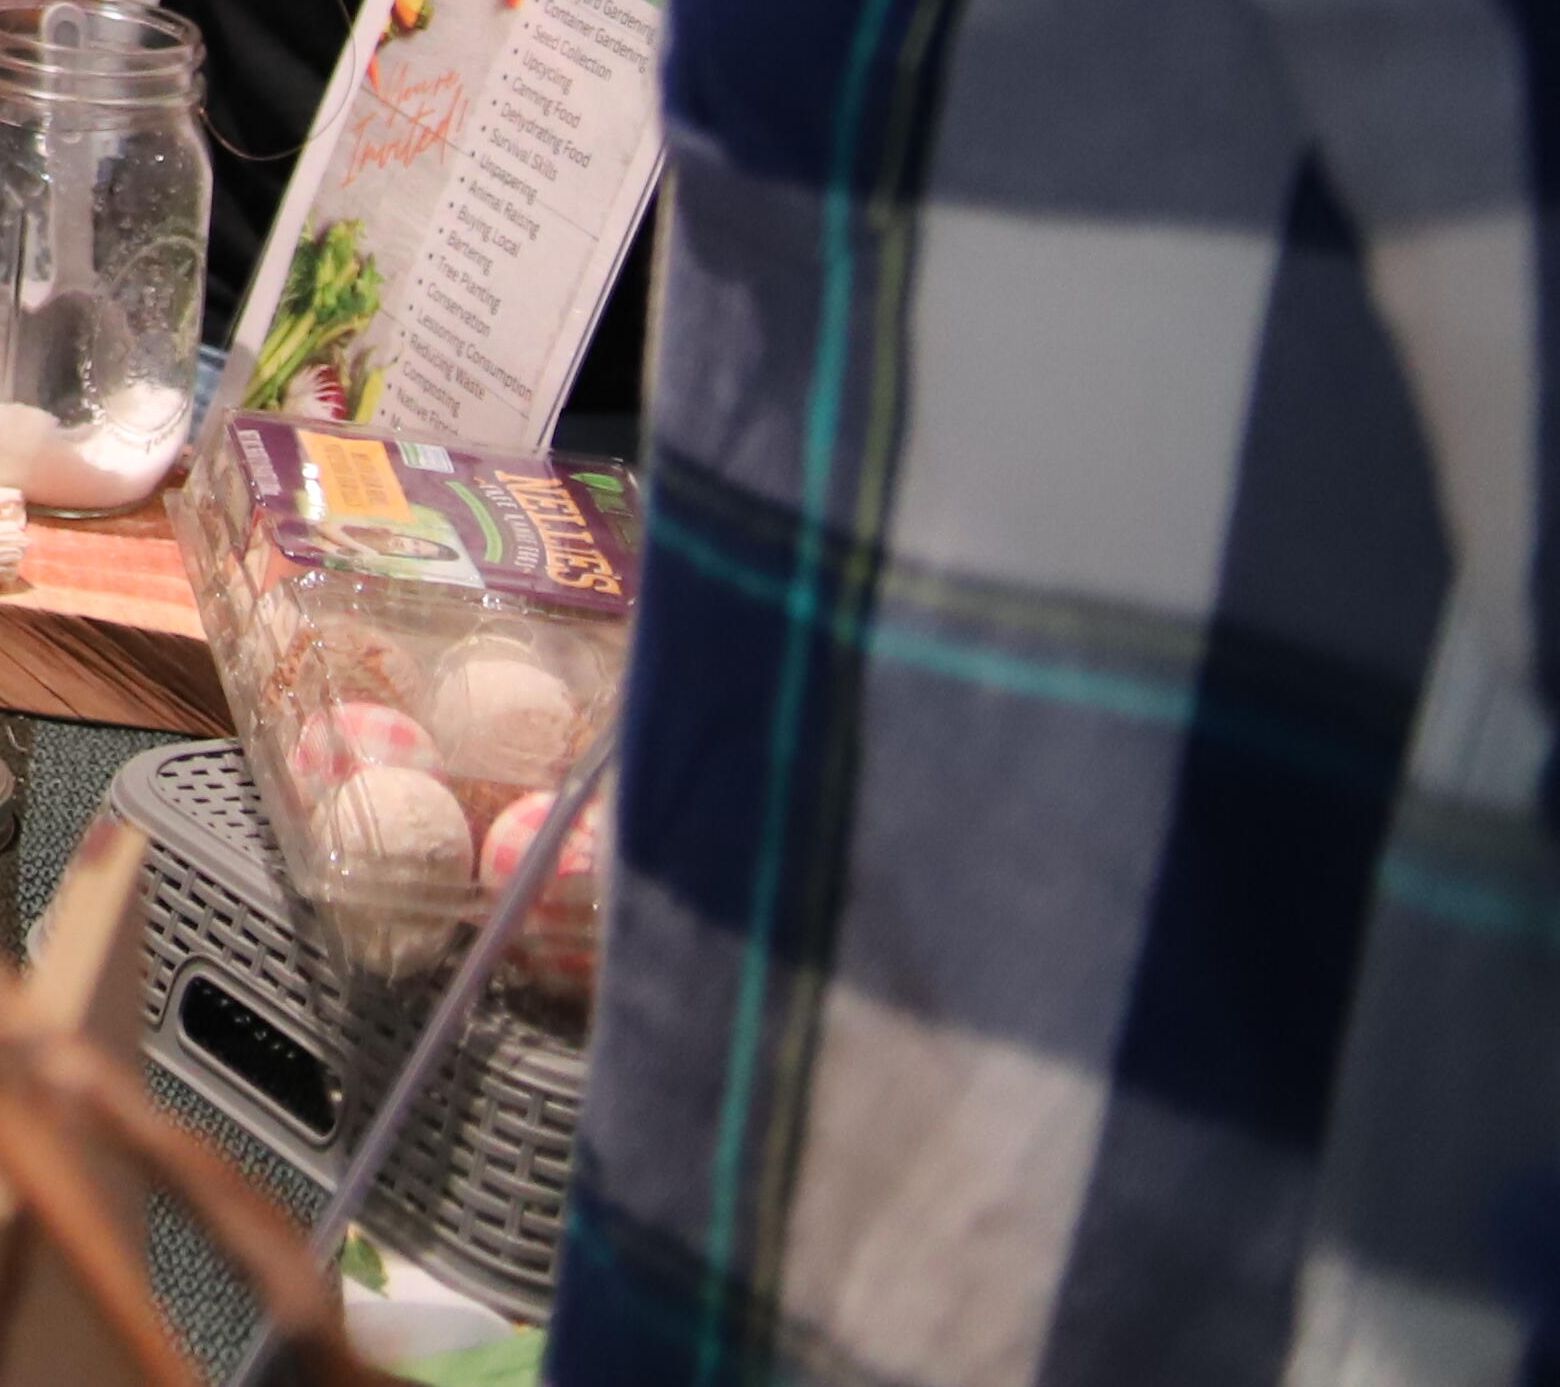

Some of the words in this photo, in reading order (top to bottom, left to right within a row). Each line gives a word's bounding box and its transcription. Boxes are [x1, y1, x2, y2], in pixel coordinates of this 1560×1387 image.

[522, 50, 573, 95] Upcycling
[533, 25, 559, 50] Seed
[559, 36, 613, 82] Collection
[595, 28, 650, 74] Gardening
[499, 101, 563, 157] Dehydrating
[562, 139, 592, 169] Food
[553, 100, 583, 128] Food
[489, 128, 532, 164] Survival
[530, 154, 560, 182] Skills
[456, 204, 492, 243] Buying
[491, 228, 521, 258] Local
[468, 180, 505, 211] Animal
[503, 201, 542, 241] Raising
[446, 230, 494, 276] Bartering
[426, 282, 492, 338] Conservation
[436, 254, 461, 280] Tree
[458, 269, 502, 316] Planting
[402, 360, 462, 418] Composting
[408, 332, 456, 380] Reducing
[455, 371, 488, 401] Waste
[465, 342, 534, 403] Consumption
[494, 469, 622, 596] NELLIE'S
